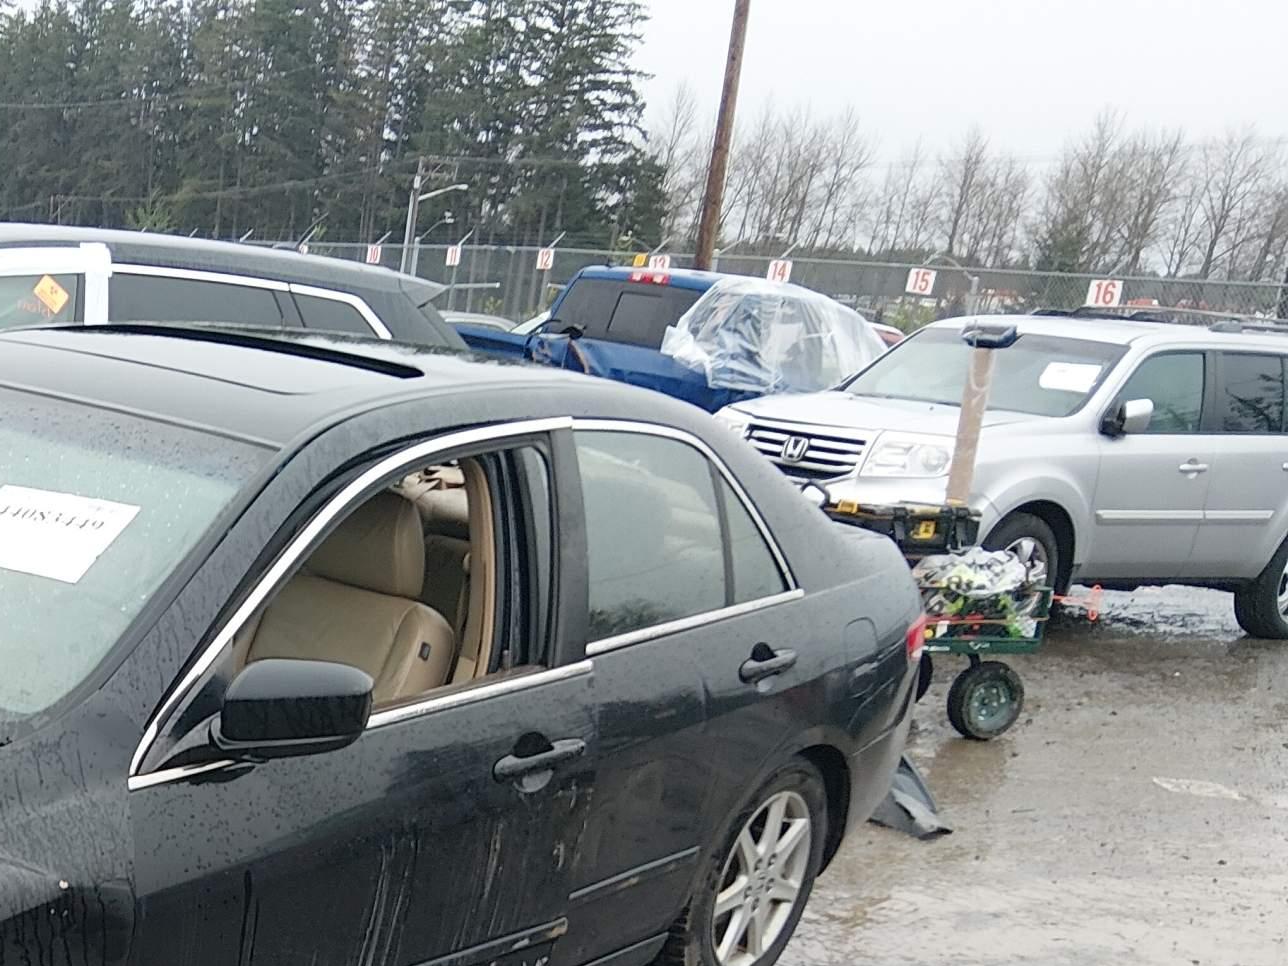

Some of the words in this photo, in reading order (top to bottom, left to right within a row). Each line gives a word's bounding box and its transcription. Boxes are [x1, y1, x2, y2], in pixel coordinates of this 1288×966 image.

[369, 247, 379, 262] 10
[450, 248, 459, 264] 11
[540, 251, 552, 268] 12
[773, 262, 787, 281] 14
[913, 270, 931, 292] 15
[1094, 282, 1117, 305] 16
